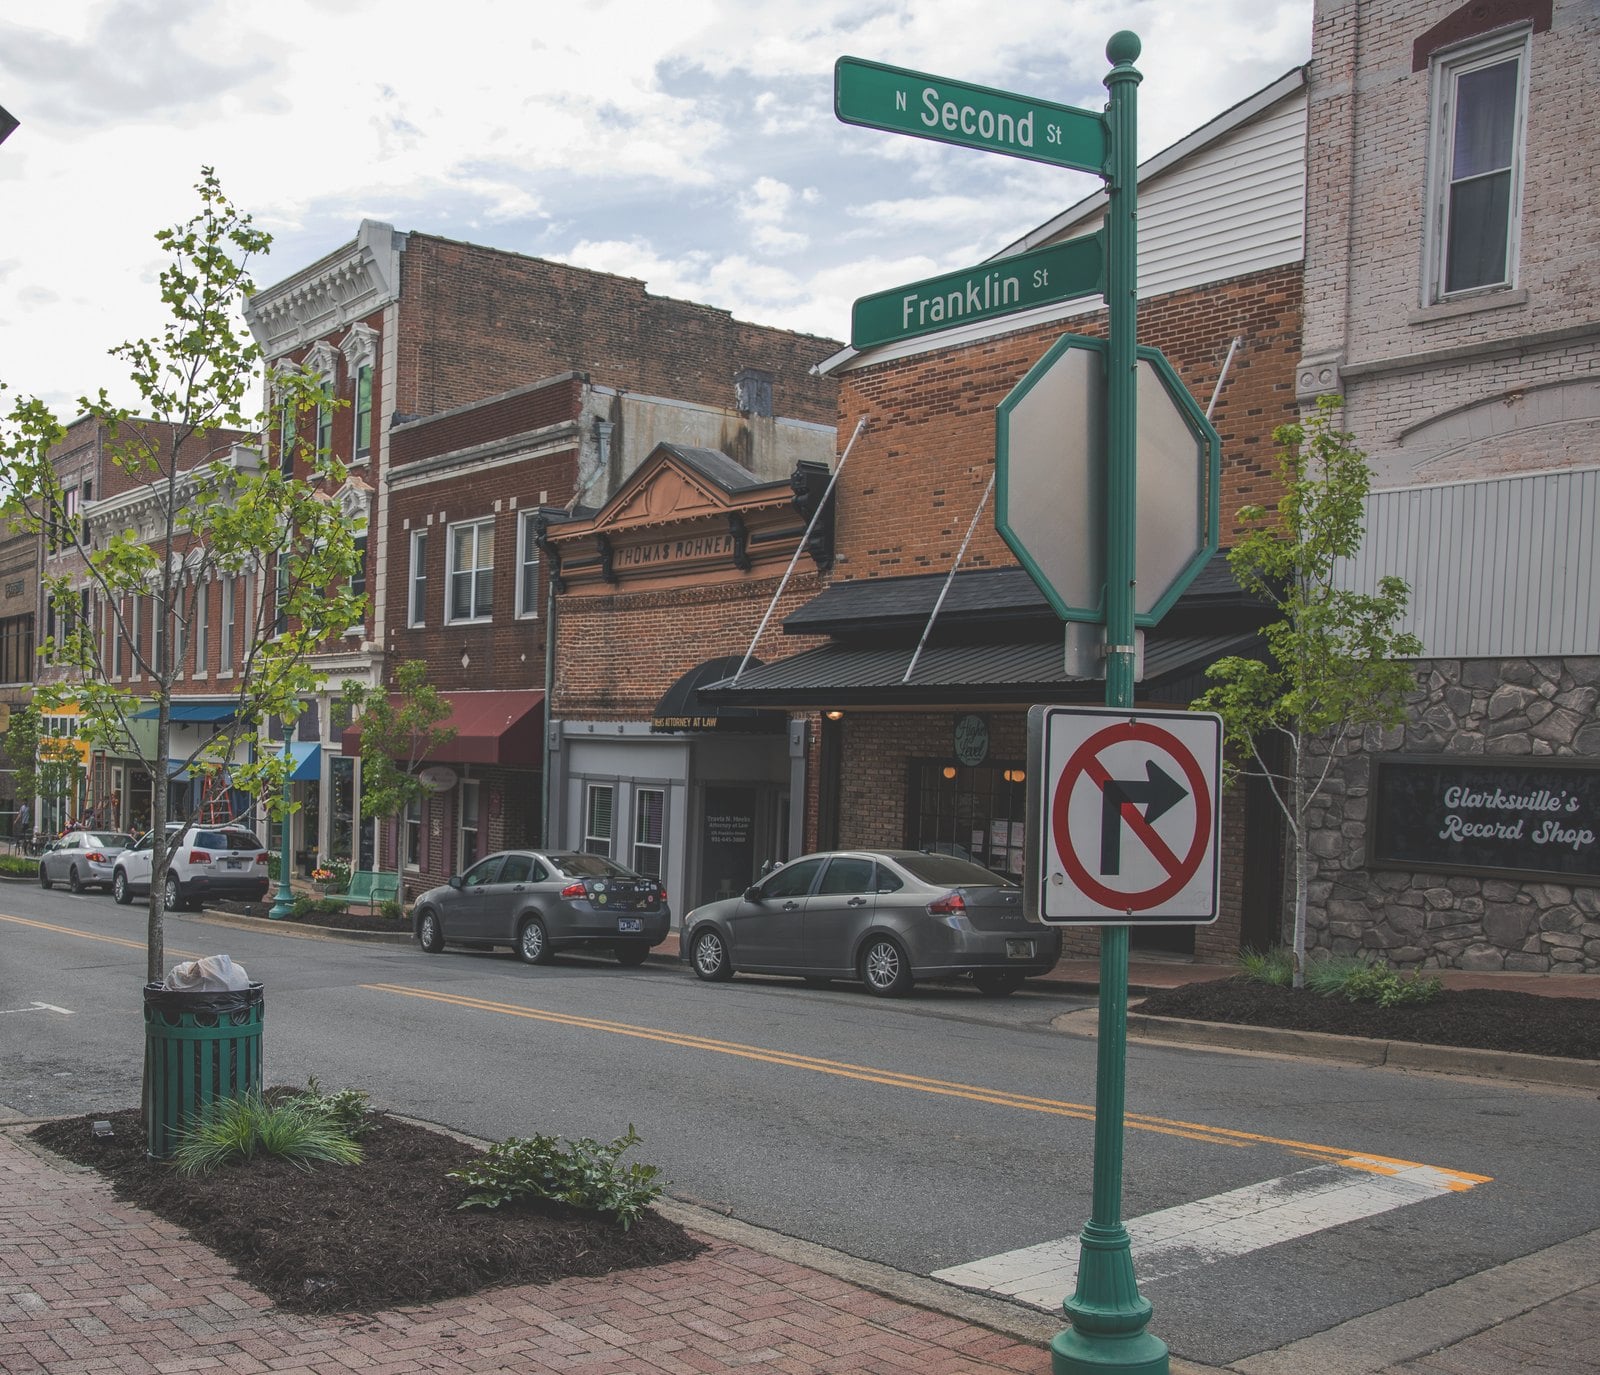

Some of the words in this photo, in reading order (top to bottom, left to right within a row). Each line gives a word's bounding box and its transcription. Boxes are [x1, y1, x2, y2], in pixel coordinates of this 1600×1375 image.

[895, 90, 907, 112] N
[920, 87, 1034, 148] Second
[1046, 123, 1062, 145] St
[902, 271, 1020, 330] Franklin
[1032, 268, 1049, 289] St
[617, 543, 671, 566] THOMAS
[675, 535, 734, 559] ROHNER
[665, 717, 692, 727] ATTORNEY
[693, 717, 701, 727] AT
[702, 717, 718, 727] LAW
[1444, 786, 1580, 813] Clarksville's
[709, 822, 731, 830] Attorney
[1438, 814, 1524, 842] Record
[1531, 820, 1596, 851] Shop
